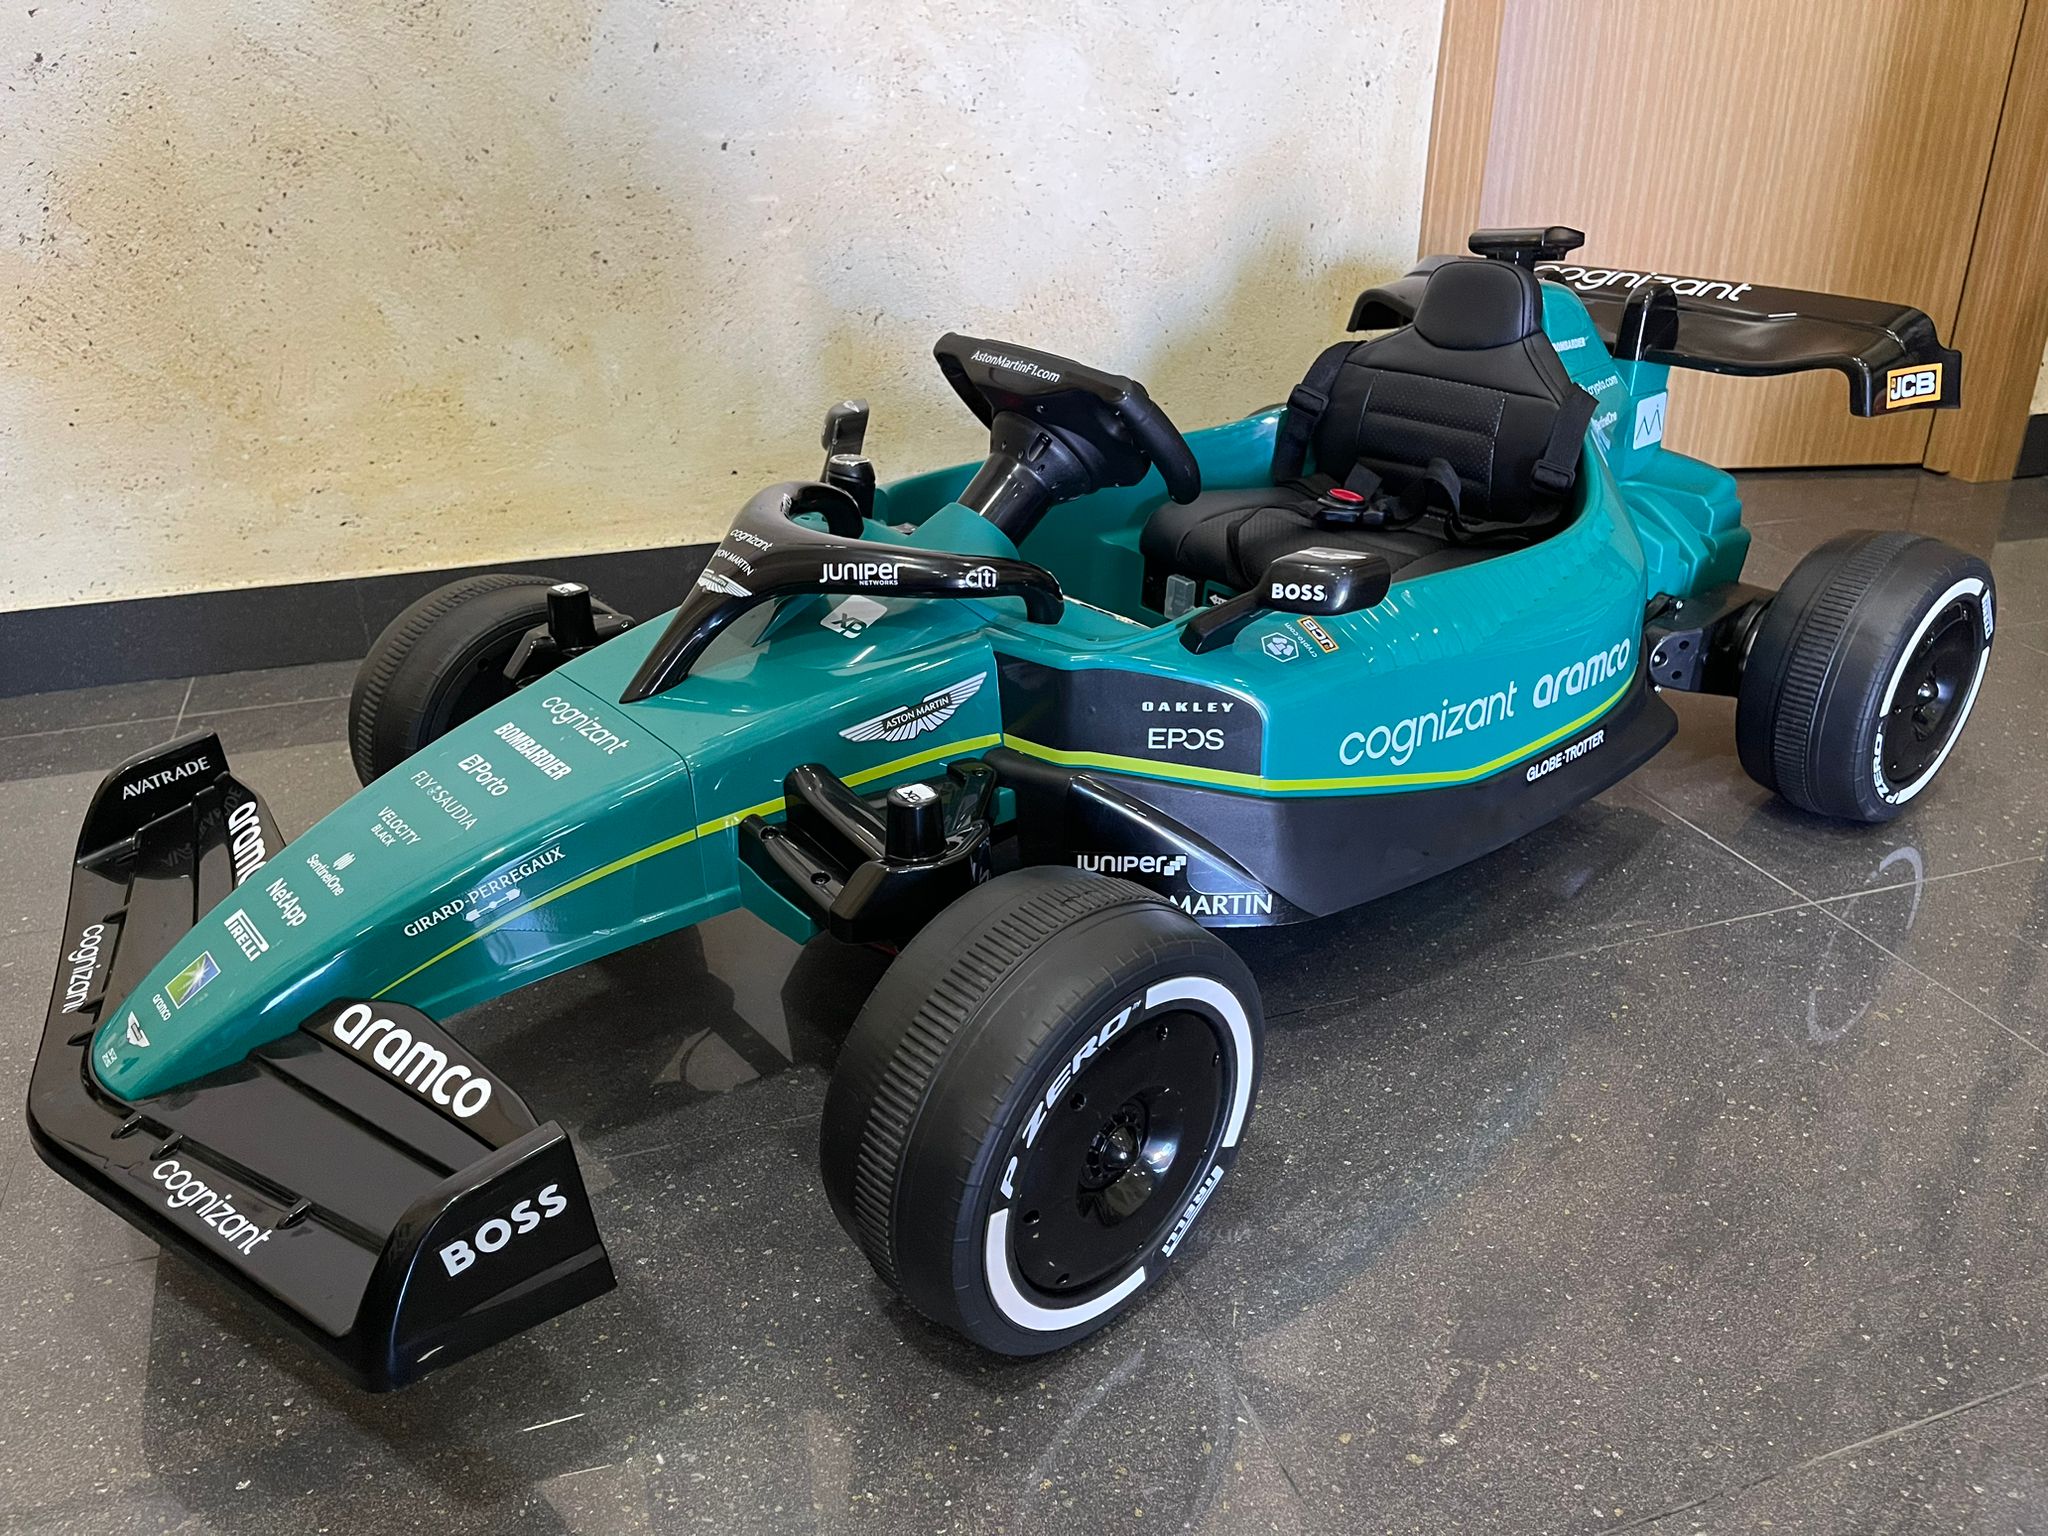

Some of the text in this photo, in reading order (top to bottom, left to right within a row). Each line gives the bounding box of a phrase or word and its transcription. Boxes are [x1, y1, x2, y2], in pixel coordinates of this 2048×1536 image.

[971, 349, 1061, 384] AstonMartinF1.com
[1890, 371, 1936, 400] JCB
[730, 528, 773, 552] cognizant
[965, 566, 998, 589] citi
[1271, 582, 1326, 602] BOSS
[1302, 619, 1336, 650] JCB
[1533, 638, 1631, 709] aramco
[541, 696, 630, 755] cognizant
[885, 695, 950, 730] ASTON MARTIN
[1141, 701, 1235, 713] OAKLEY
[1338, 680, 1518, 767] cognizant
[494, 721, 573, 781] BOMBARDIER
[1147, 727, 1226, 750] EPOS
[122, 755, 212, 801] AVATRADE
[410, 770, 478, 831] FLY SAUDIA
[228, 801, 267, 887] aramc
[370, 822, 397, 848] BLACK
[376, 805, 422, 846] VELOCITY
[306, 853, 345, 897] SentinelOne
[403, 846, 567, 938] GIRARD-PERREGAUX
[265, 877, 308, 927] NetApp
[223, 907, 270, 962] PIRELLI
[61, 924, 105, 1014] cognizant
[152, 993, 172, 1021] aramco
[333, 1003, 492, 1118] aramco
[152, 1160, 273, 1256] cognizant
[439, 1183, 568, 1278] BOSS
[1161, 1165, 1225, 1258] PIRELLI
